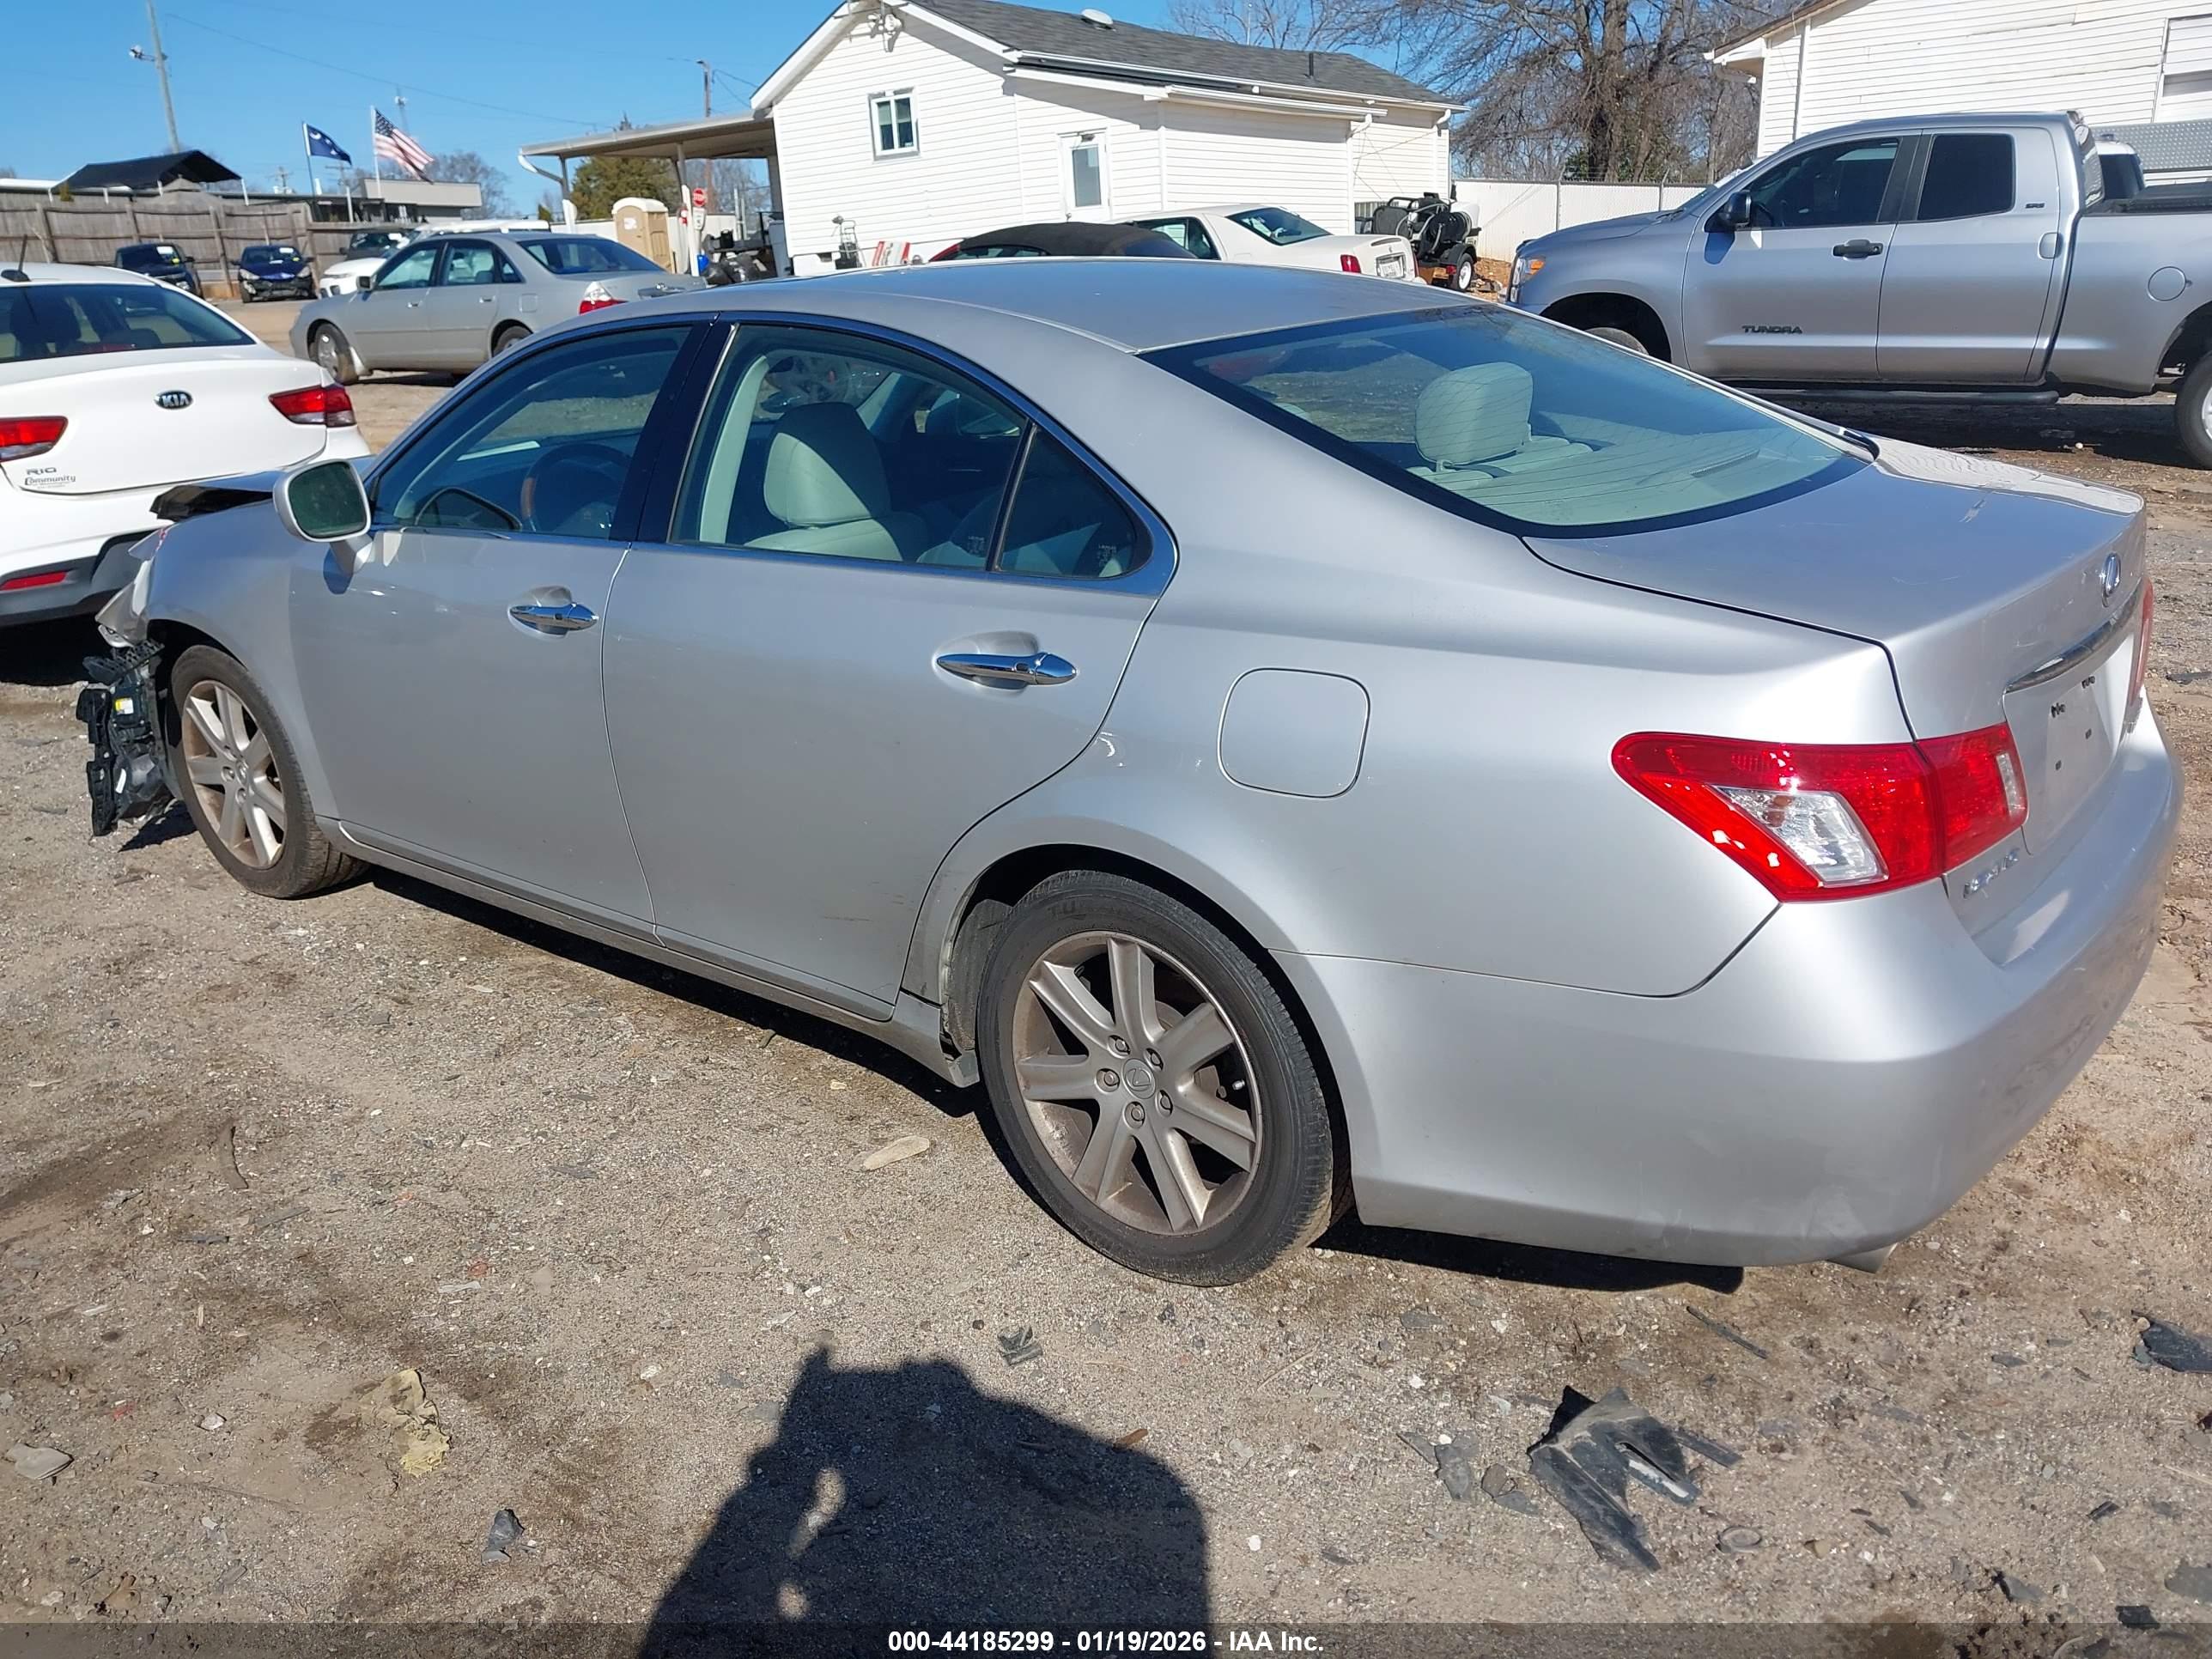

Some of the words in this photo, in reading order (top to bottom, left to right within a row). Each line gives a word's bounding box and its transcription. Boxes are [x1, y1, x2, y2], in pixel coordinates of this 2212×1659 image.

[1741, 325, 1802, 334] TUNDRA
[161, 393, 190, 407] KIA
[25, 475, 76, 485] Community
